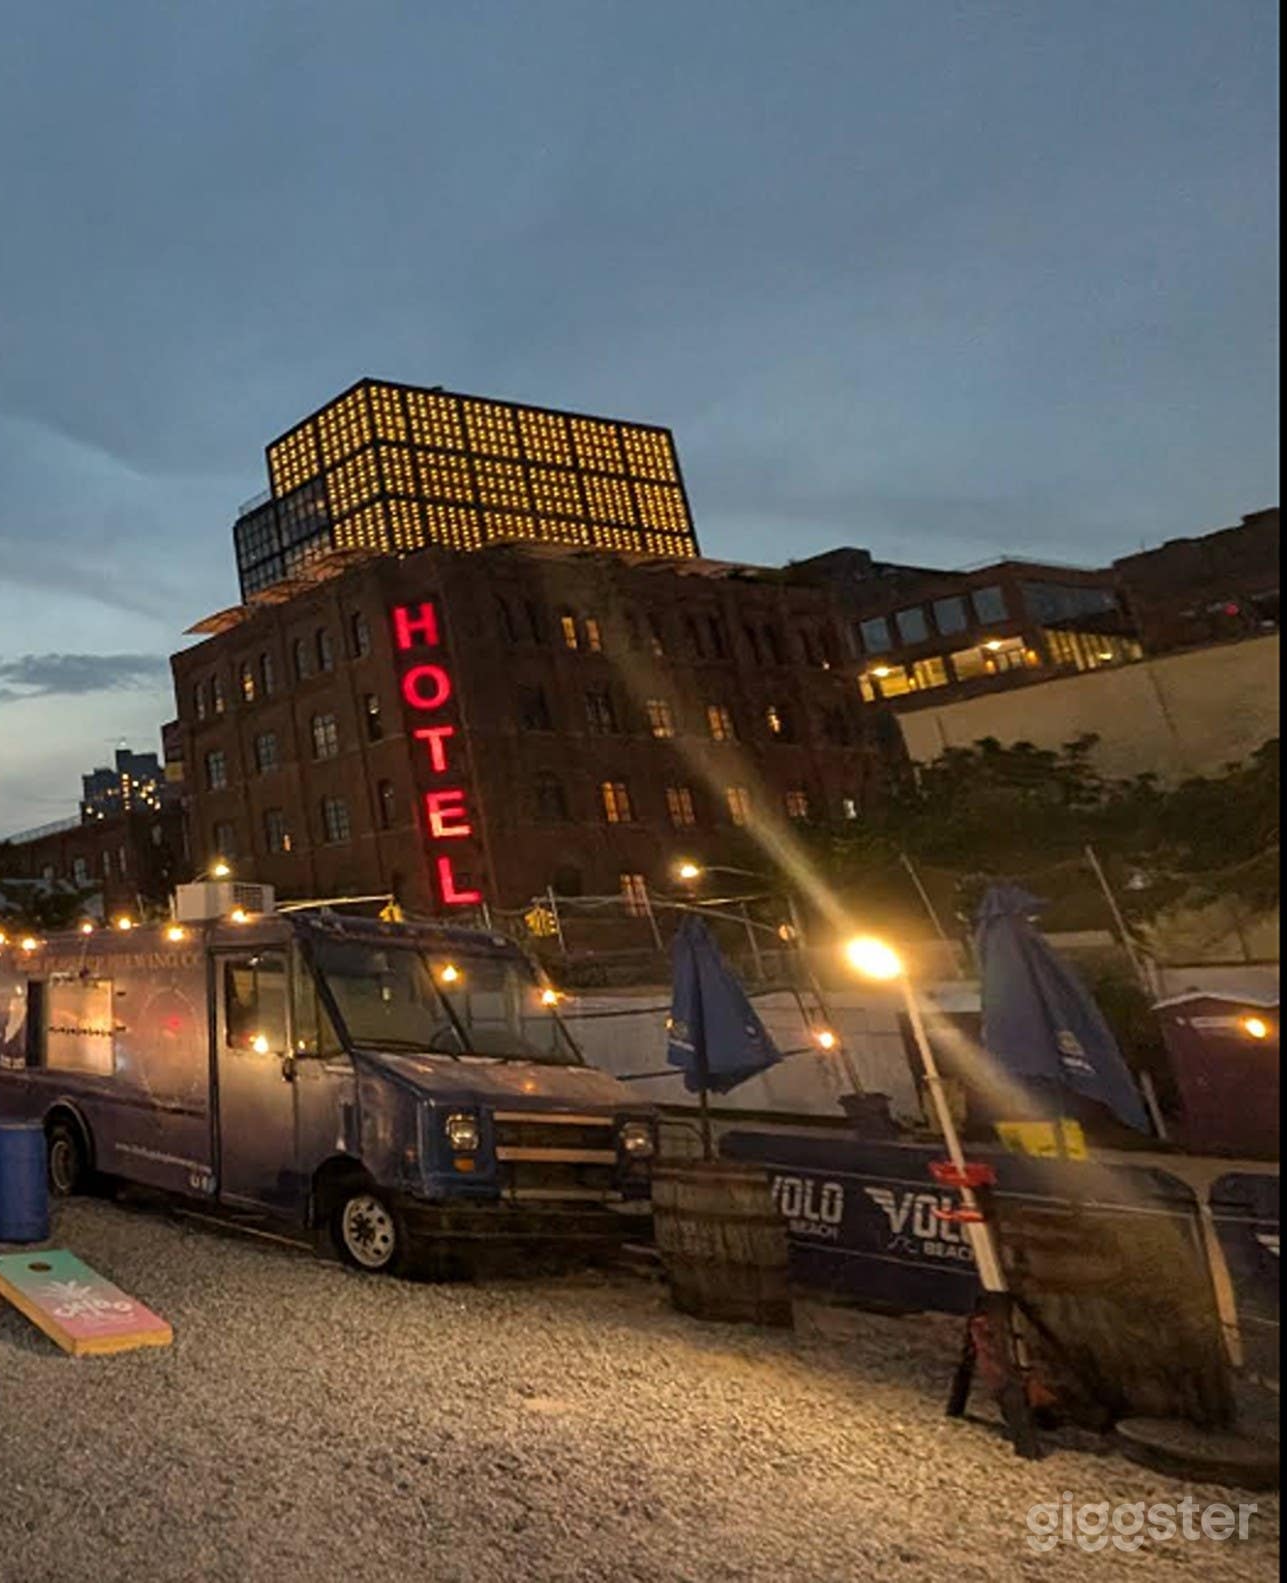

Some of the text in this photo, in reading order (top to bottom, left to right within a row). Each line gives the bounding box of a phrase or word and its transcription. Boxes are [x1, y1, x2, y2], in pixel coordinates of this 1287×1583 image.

[393, 602, 482, 904] HOTEL
[865, 1187, 971, 1244] VOL
[923, 1240, 974, 1261] BEAC
